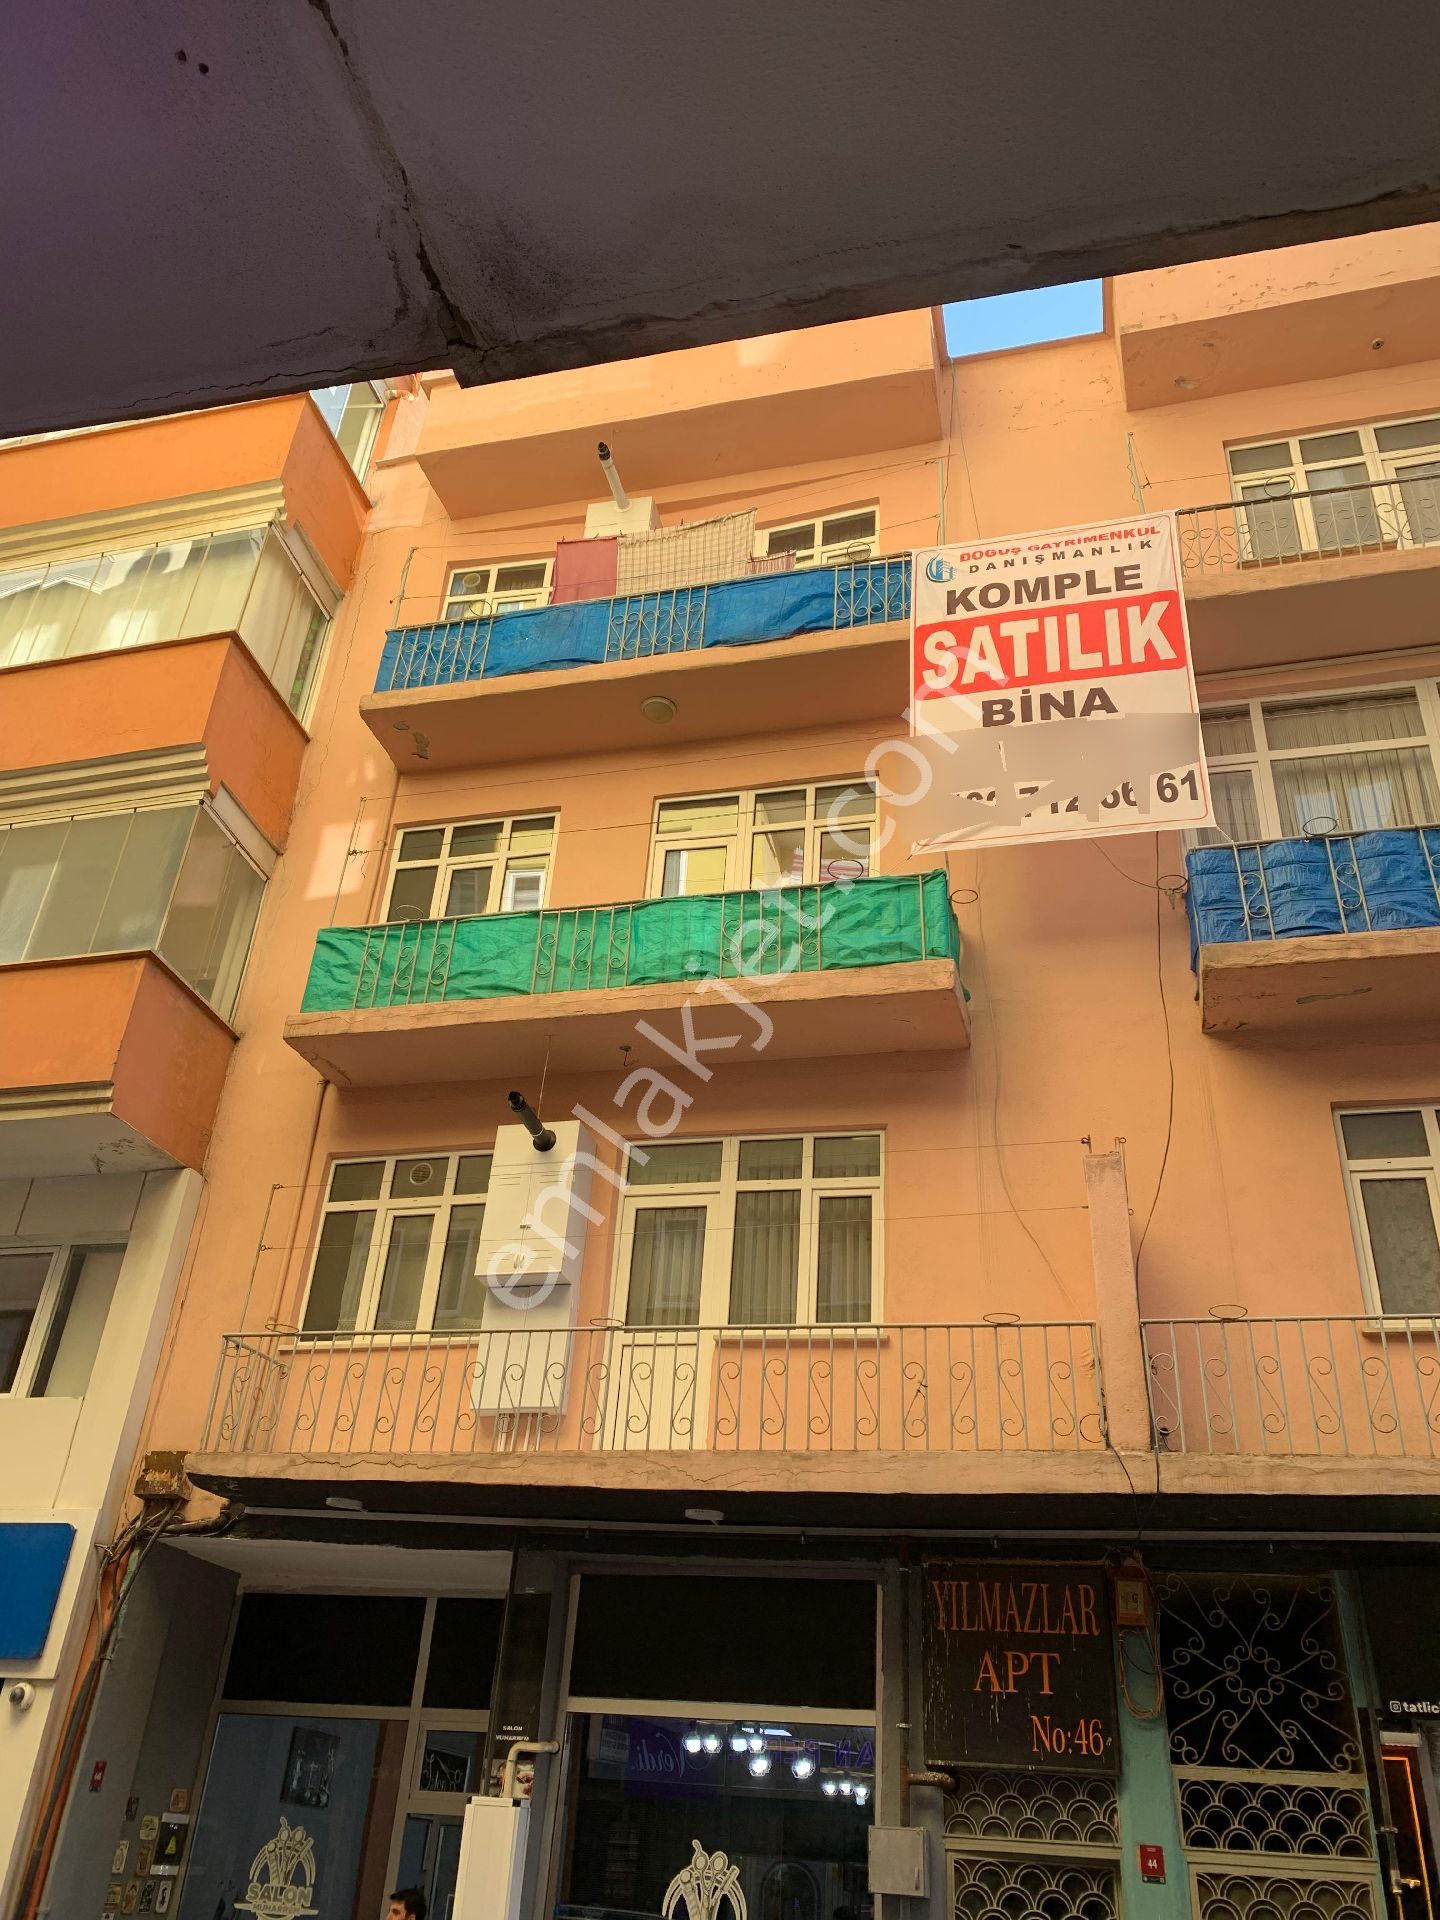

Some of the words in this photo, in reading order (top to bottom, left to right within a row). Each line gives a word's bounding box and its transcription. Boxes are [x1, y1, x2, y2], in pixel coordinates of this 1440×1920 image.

[969, 539, 1152, 574] DANIŞMANLIK
[1028, 526, 1160, 551] GAYRİMENKUL
[946, 563, 1144, 616] KOMPLE
[922, 600, 1178, 690] SATILIK
[981, 687, 1119, 728] BİNA
[1157, 769, 1199, 804] 61
[932, 1581, 1100, 1636] YILMAZLAR
[973, 1650, 1061, 1695] APT
[1030, 1715, 1104, 1756] No:46
[1147, 1858, 1158, 1870] 44
[246, 1882, 313, 1907] SALON
